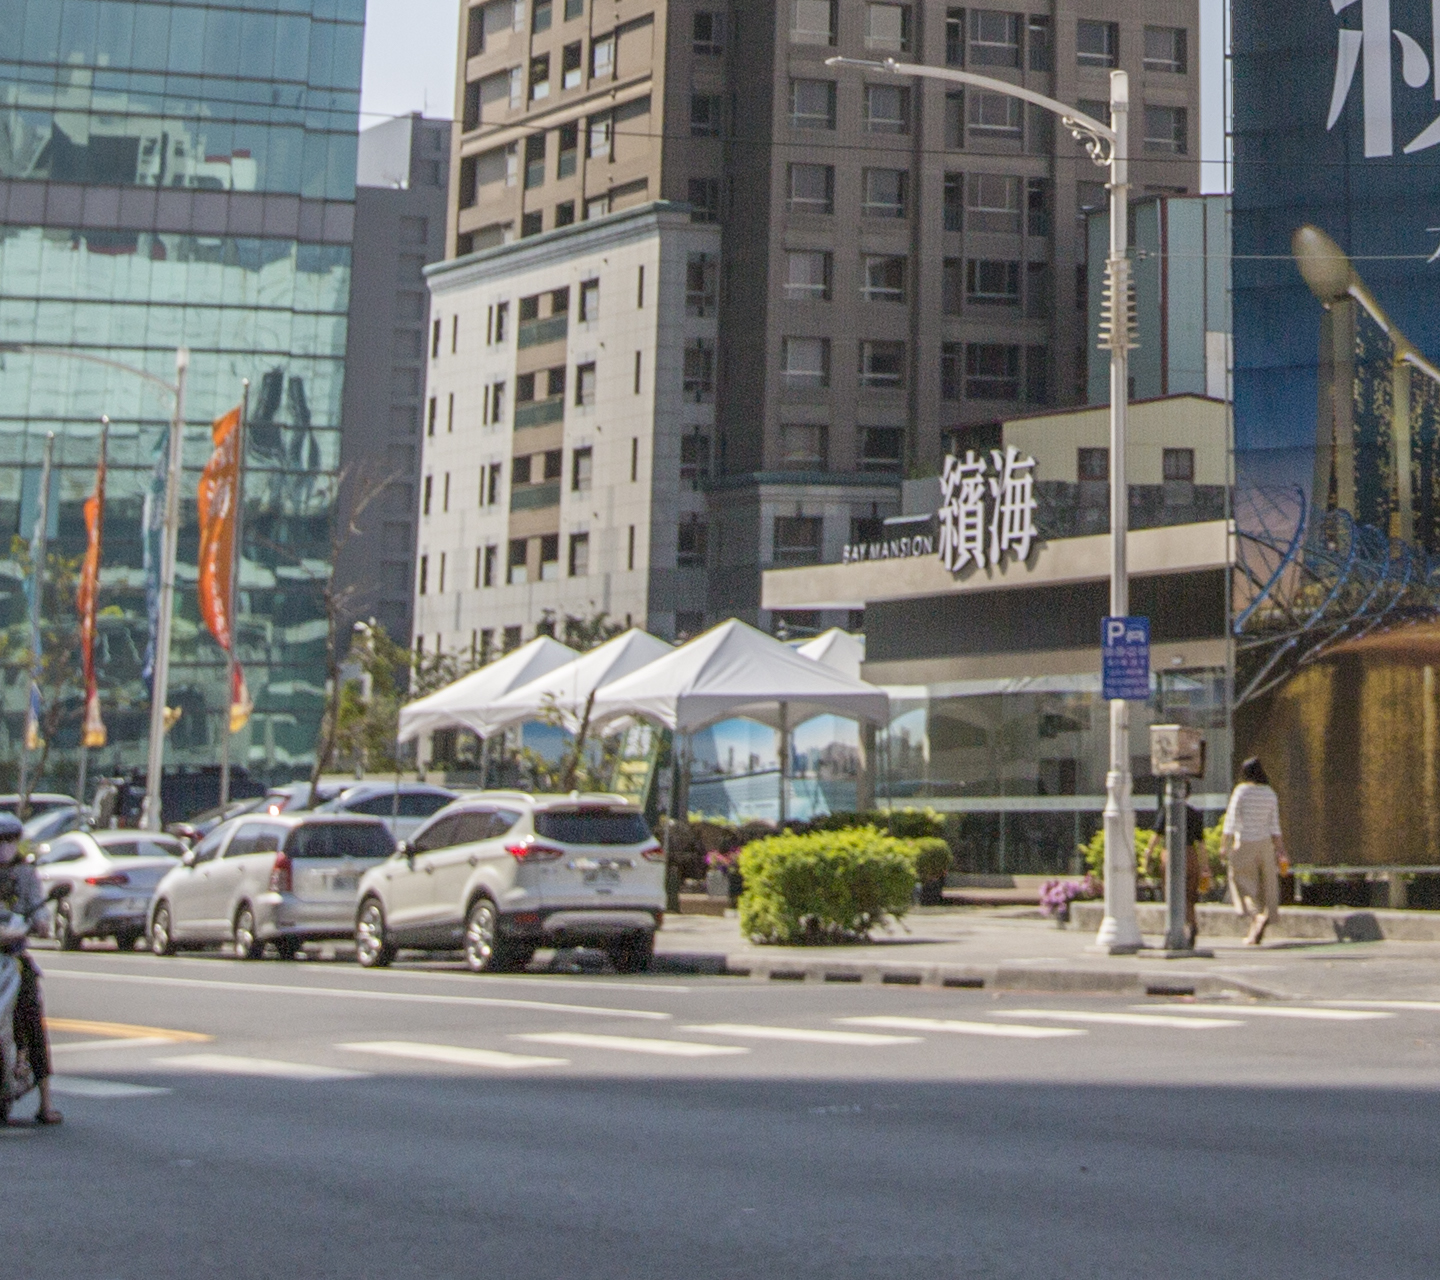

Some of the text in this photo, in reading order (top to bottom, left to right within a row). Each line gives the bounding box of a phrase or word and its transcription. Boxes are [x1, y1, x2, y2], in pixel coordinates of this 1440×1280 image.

[938, 445, 1039, 572] 繽海
[843, 535, 934, 565] BAY MANSION
[1106, 621, 1127, 648] P
